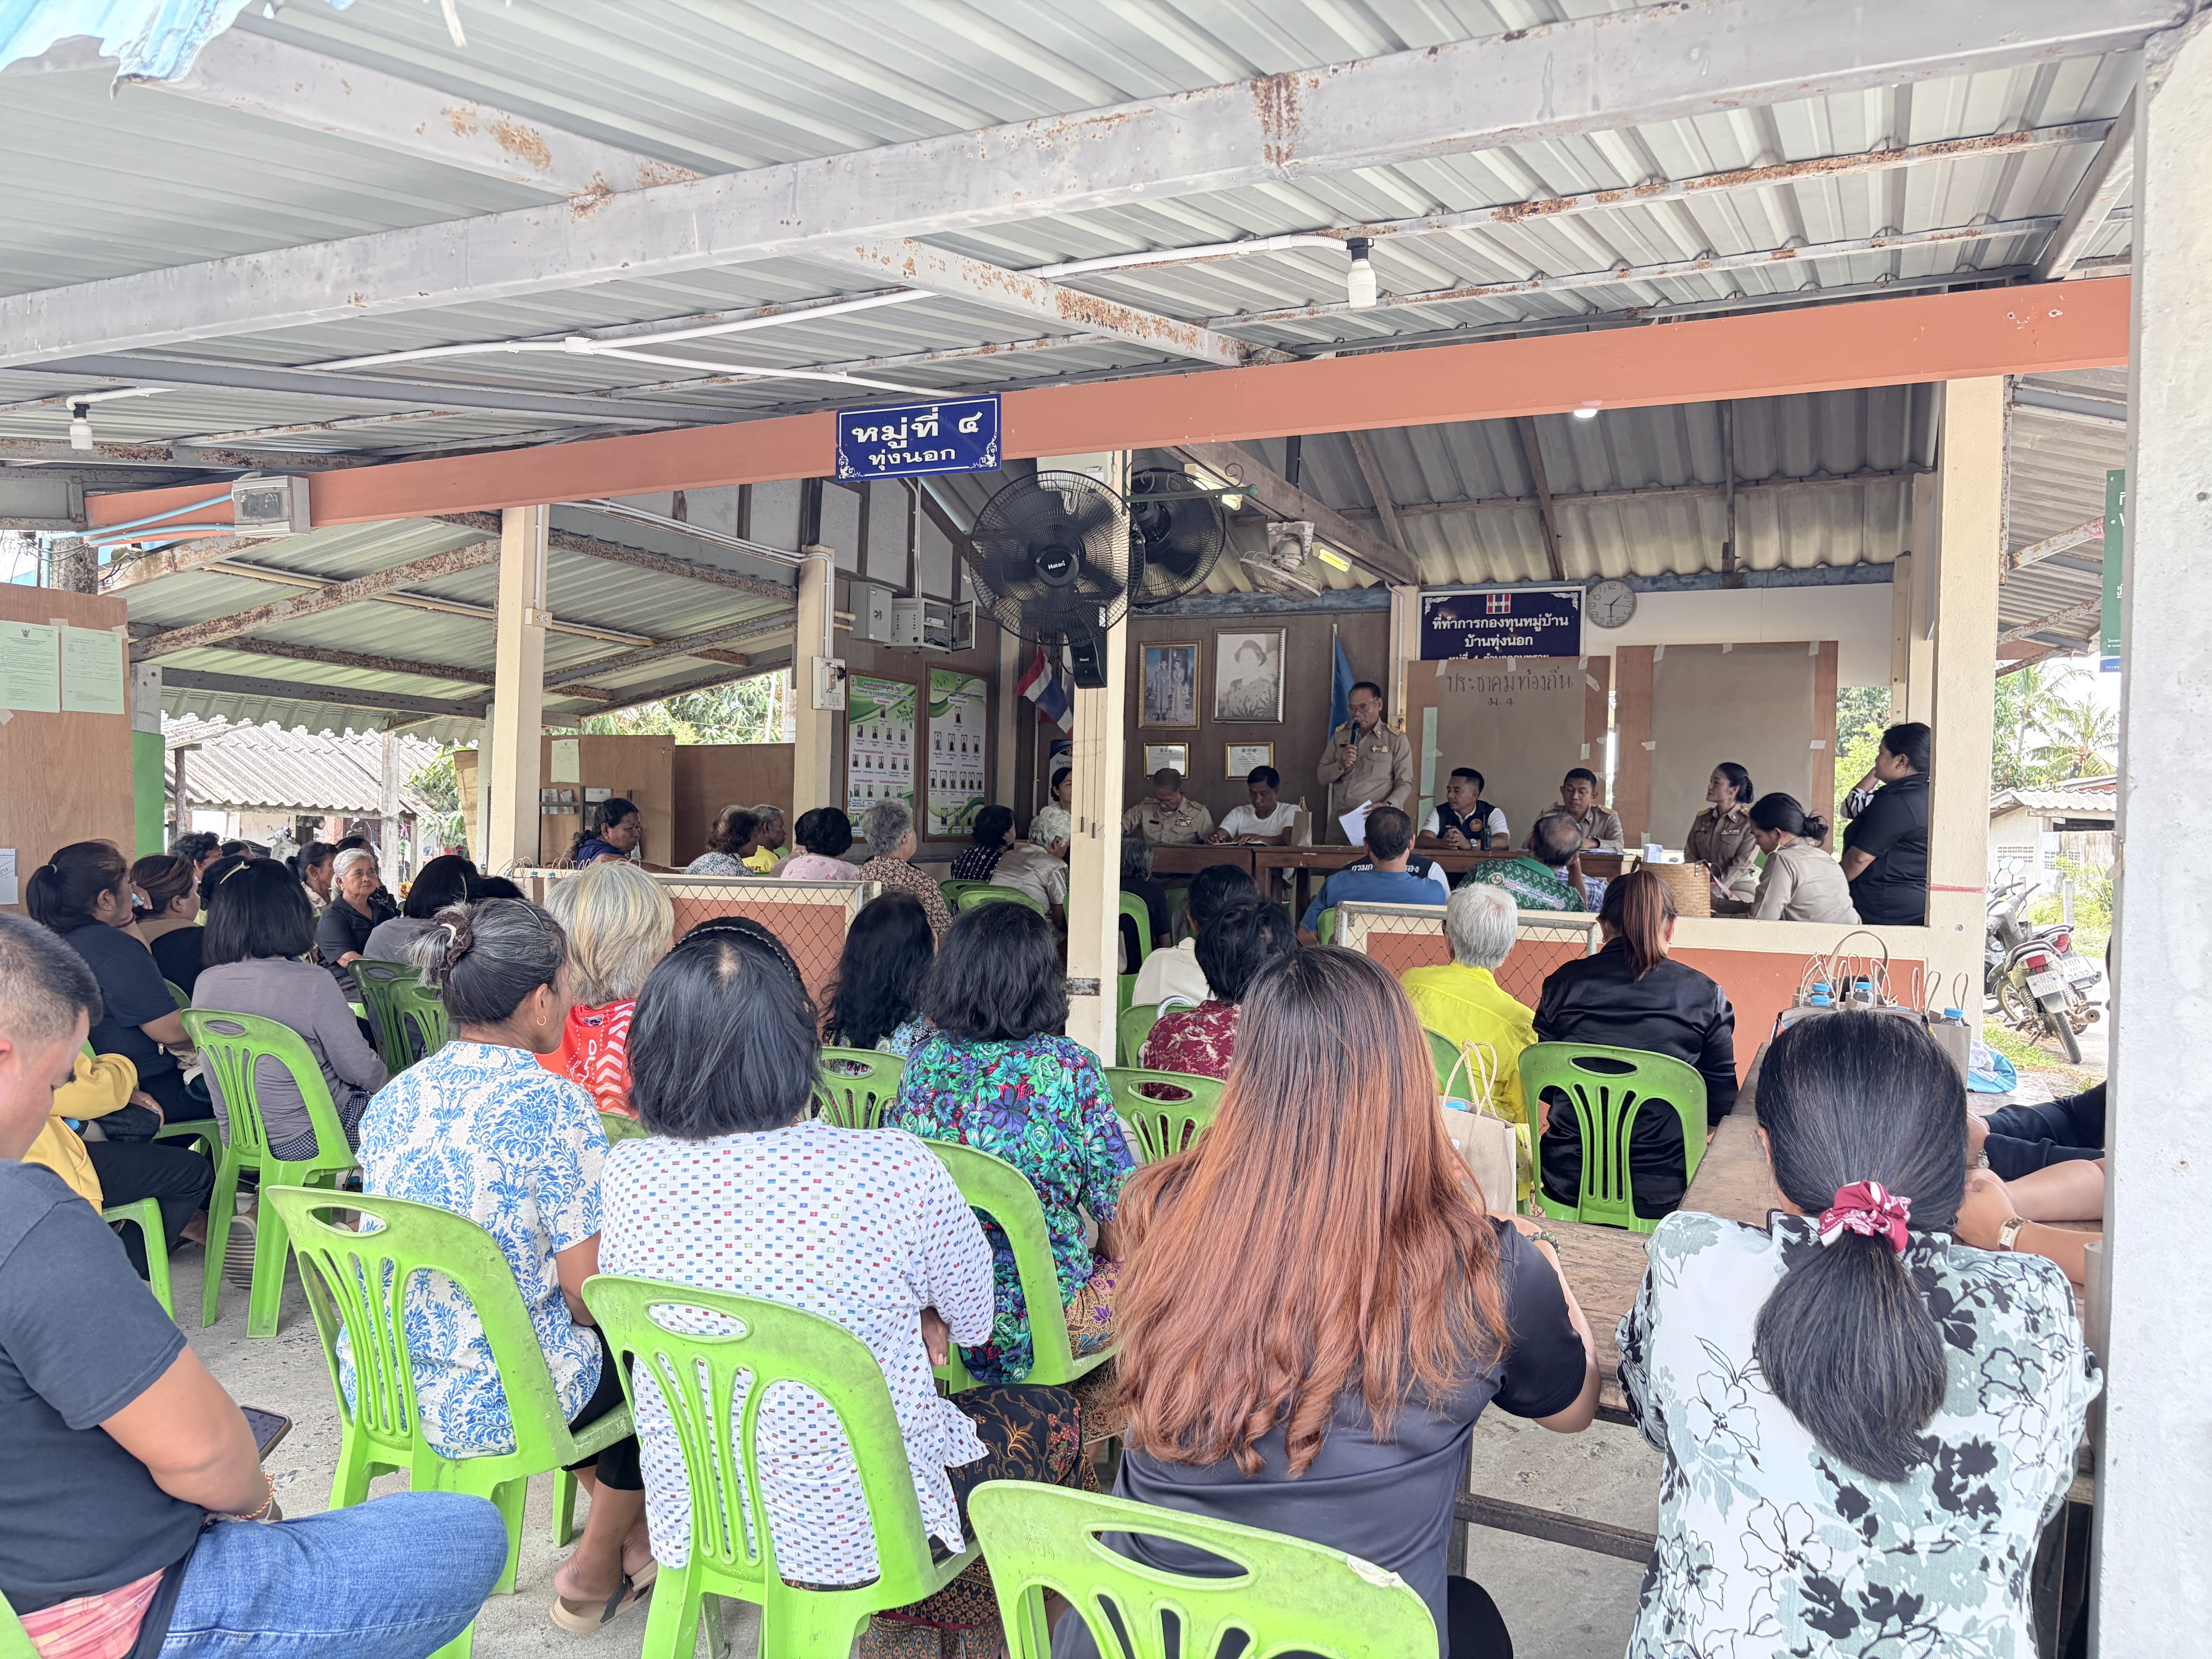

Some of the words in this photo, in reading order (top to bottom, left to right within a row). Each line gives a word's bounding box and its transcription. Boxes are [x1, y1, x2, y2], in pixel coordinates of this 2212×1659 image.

[852, 407, 938, 449] หมู่ที่
[959, 411, 983, 433] ๔
[868, 448, 955, 471] ทุ่งนอก
[1048, 560, 1066, 570] Hatari
[1432, 613, 1569, 632] ที่ทำการกองทุนหมู่บ้าน
[1465, 634, 1533, 651] บ้านทุ่งนอก
[2068, 970, 2089, 980] 3632
